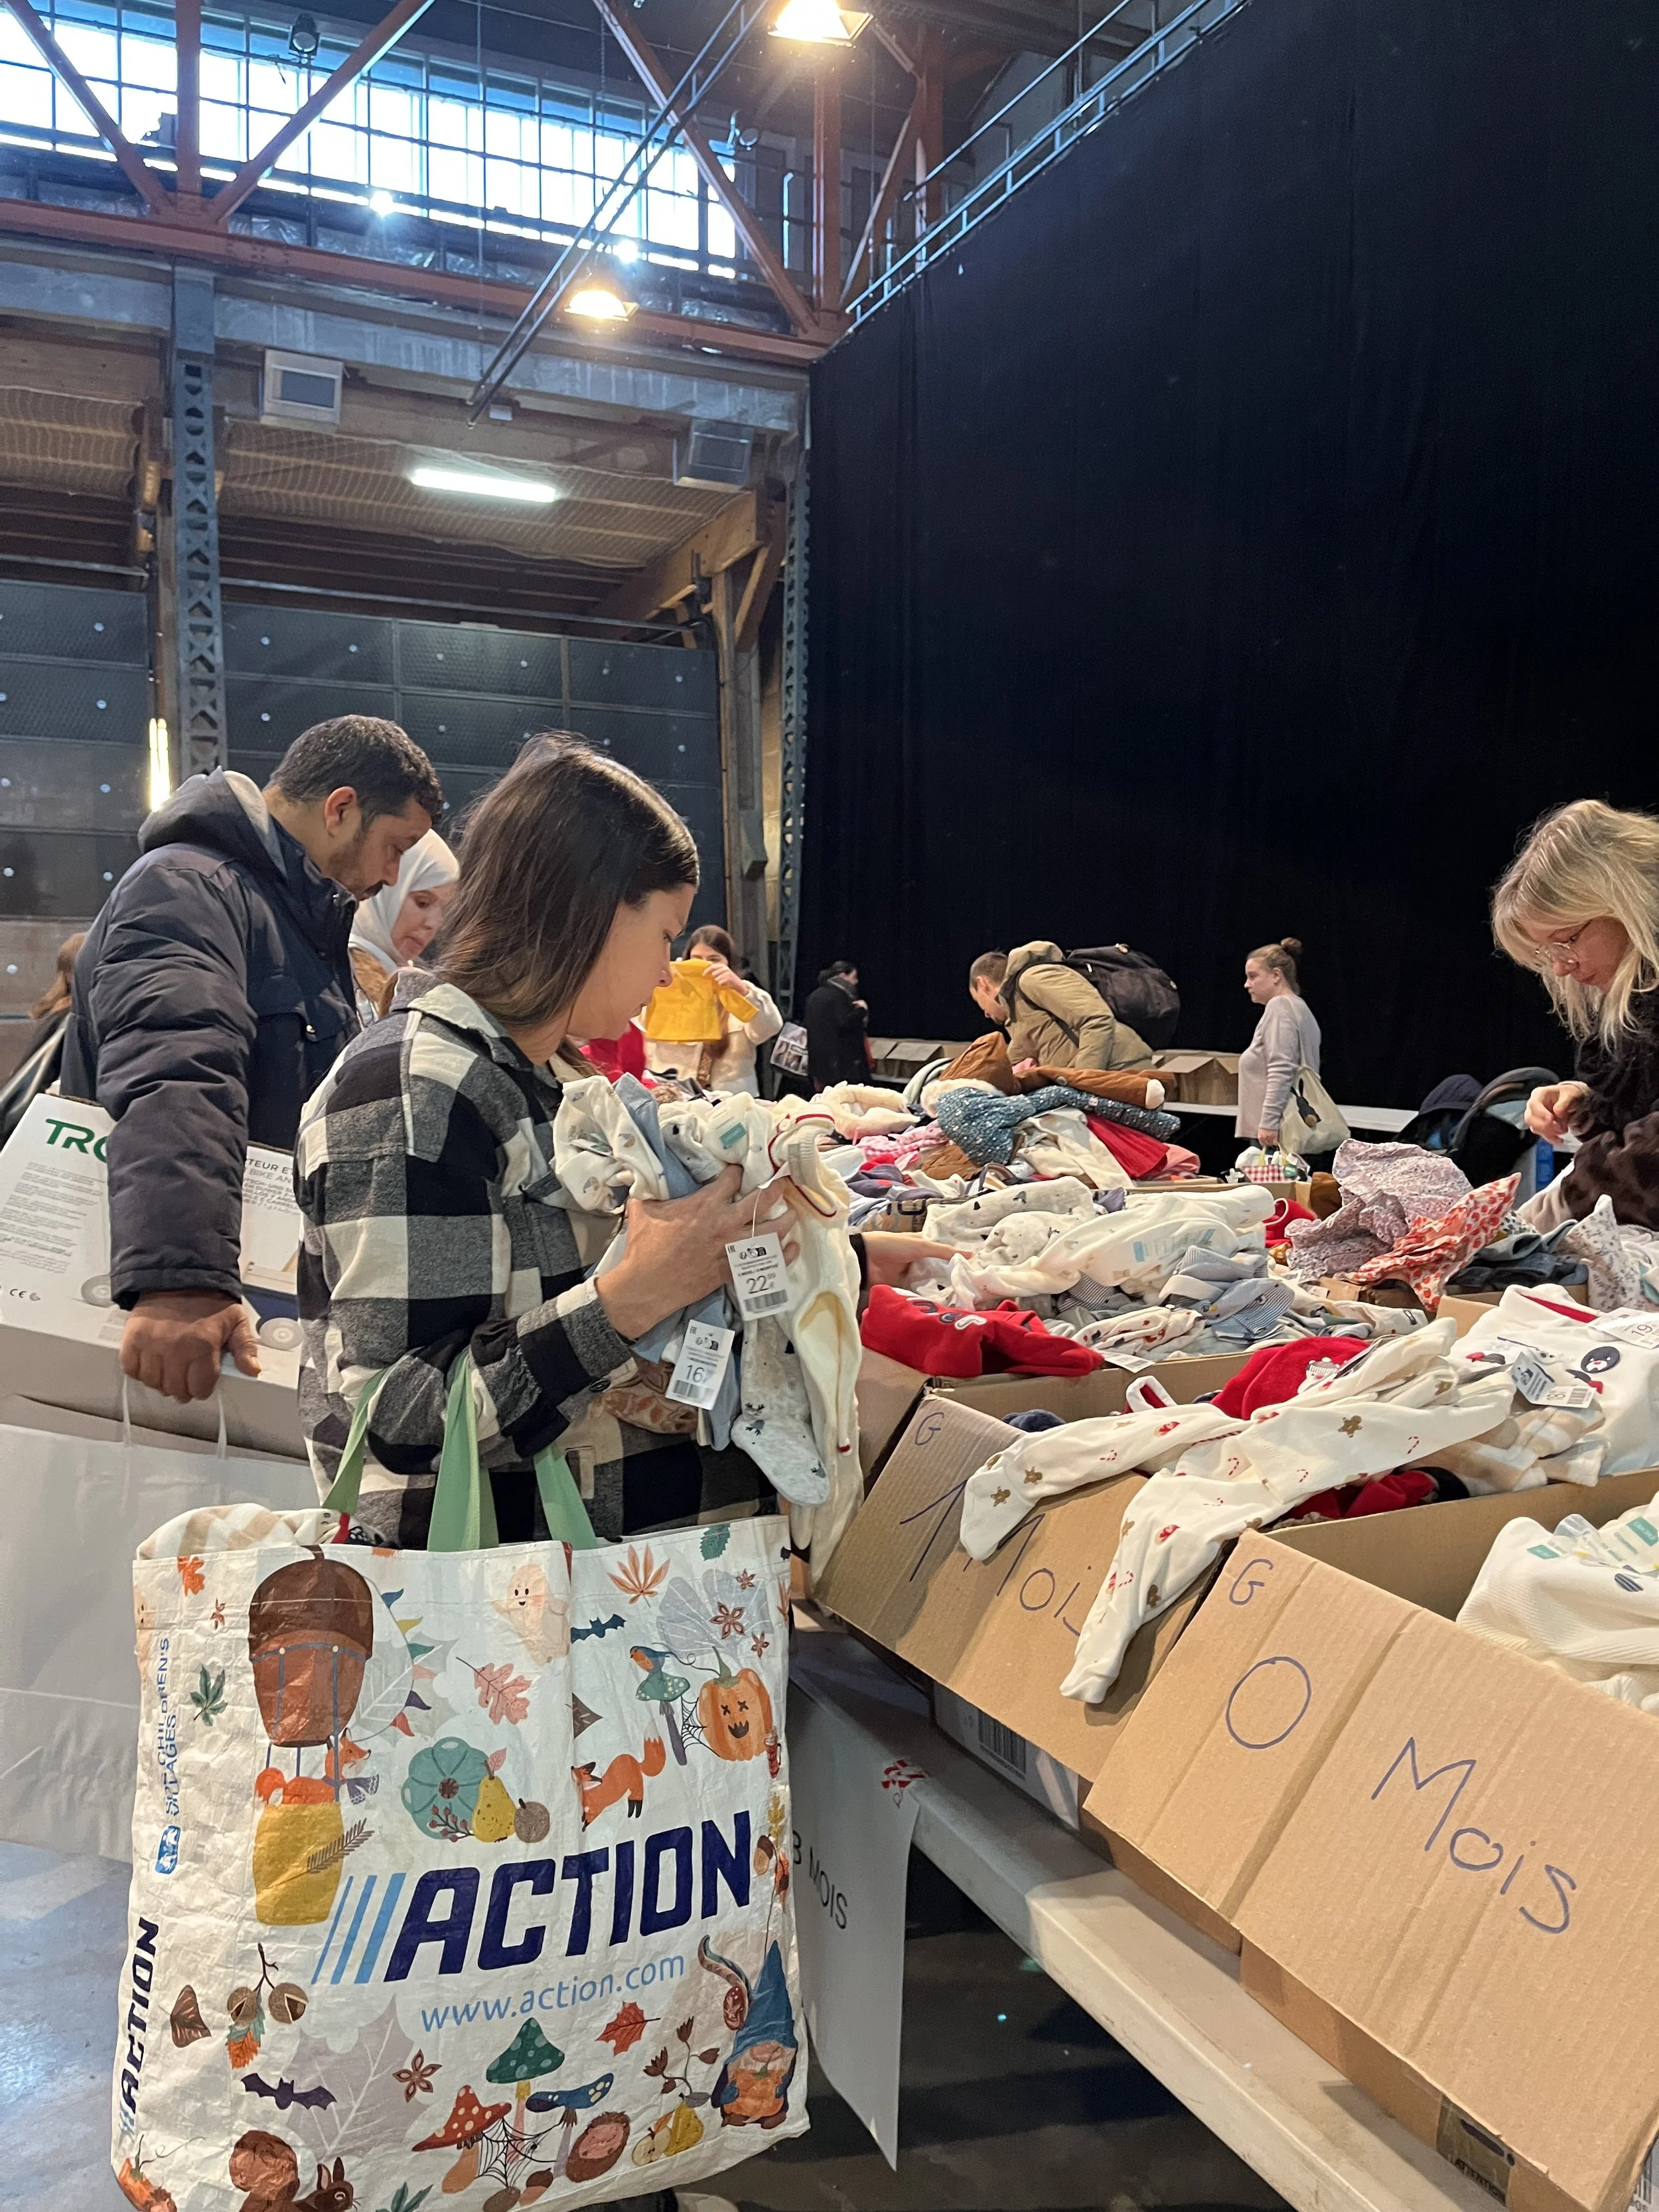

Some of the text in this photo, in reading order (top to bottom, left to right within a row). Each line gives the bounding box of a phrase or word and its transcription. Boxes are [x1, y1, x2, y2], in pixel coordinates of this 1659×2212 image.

[746, 1275, 769, 1294] 22
[1631, 1324, 1652, 1337] 19
[686, 1364, 705, 1382] 16
[915, 1412, 944, 1445] G
[1229, 1558, 1273, 1605] G
[384, 1810, 751, 1982] ACTION
[421, 1954, 684, 2033] www.action.com
[121, 1917, 159, 2114] ACTION
